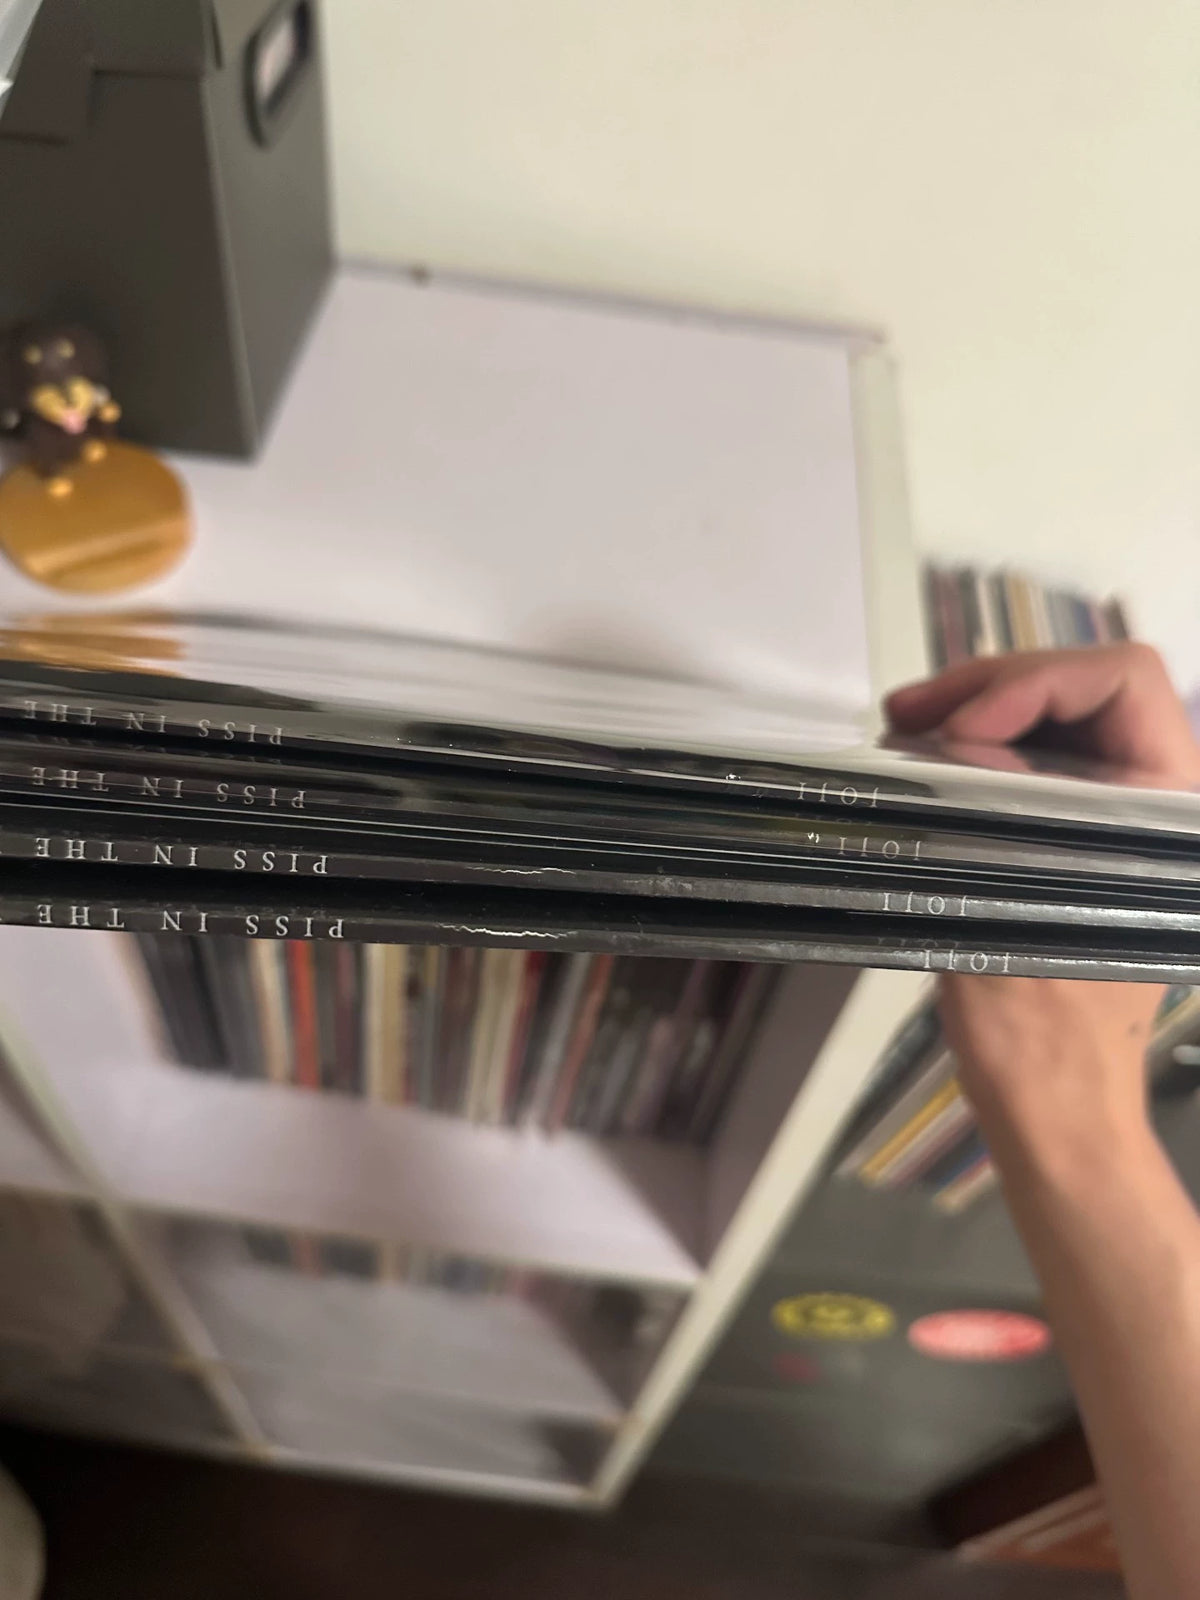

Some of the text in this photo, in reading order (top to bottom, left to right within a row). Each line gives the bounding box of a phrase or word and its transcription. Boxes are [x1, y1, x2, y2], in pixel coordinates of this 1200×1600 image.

[24, 700, 283, 746] PISS IN THE
[32, 766, 307, 809] PISS IN THE
[798, 782, 879, 808] JOJI
[36, 837, 328, 875] PISS IN THE
[839, 837, 921, 861] JOJI
[882, 892, 967, 917] JOJI
[37, 904, 344, 939] PISS IN THE
[923, 950, 1011, 973] JOJI
